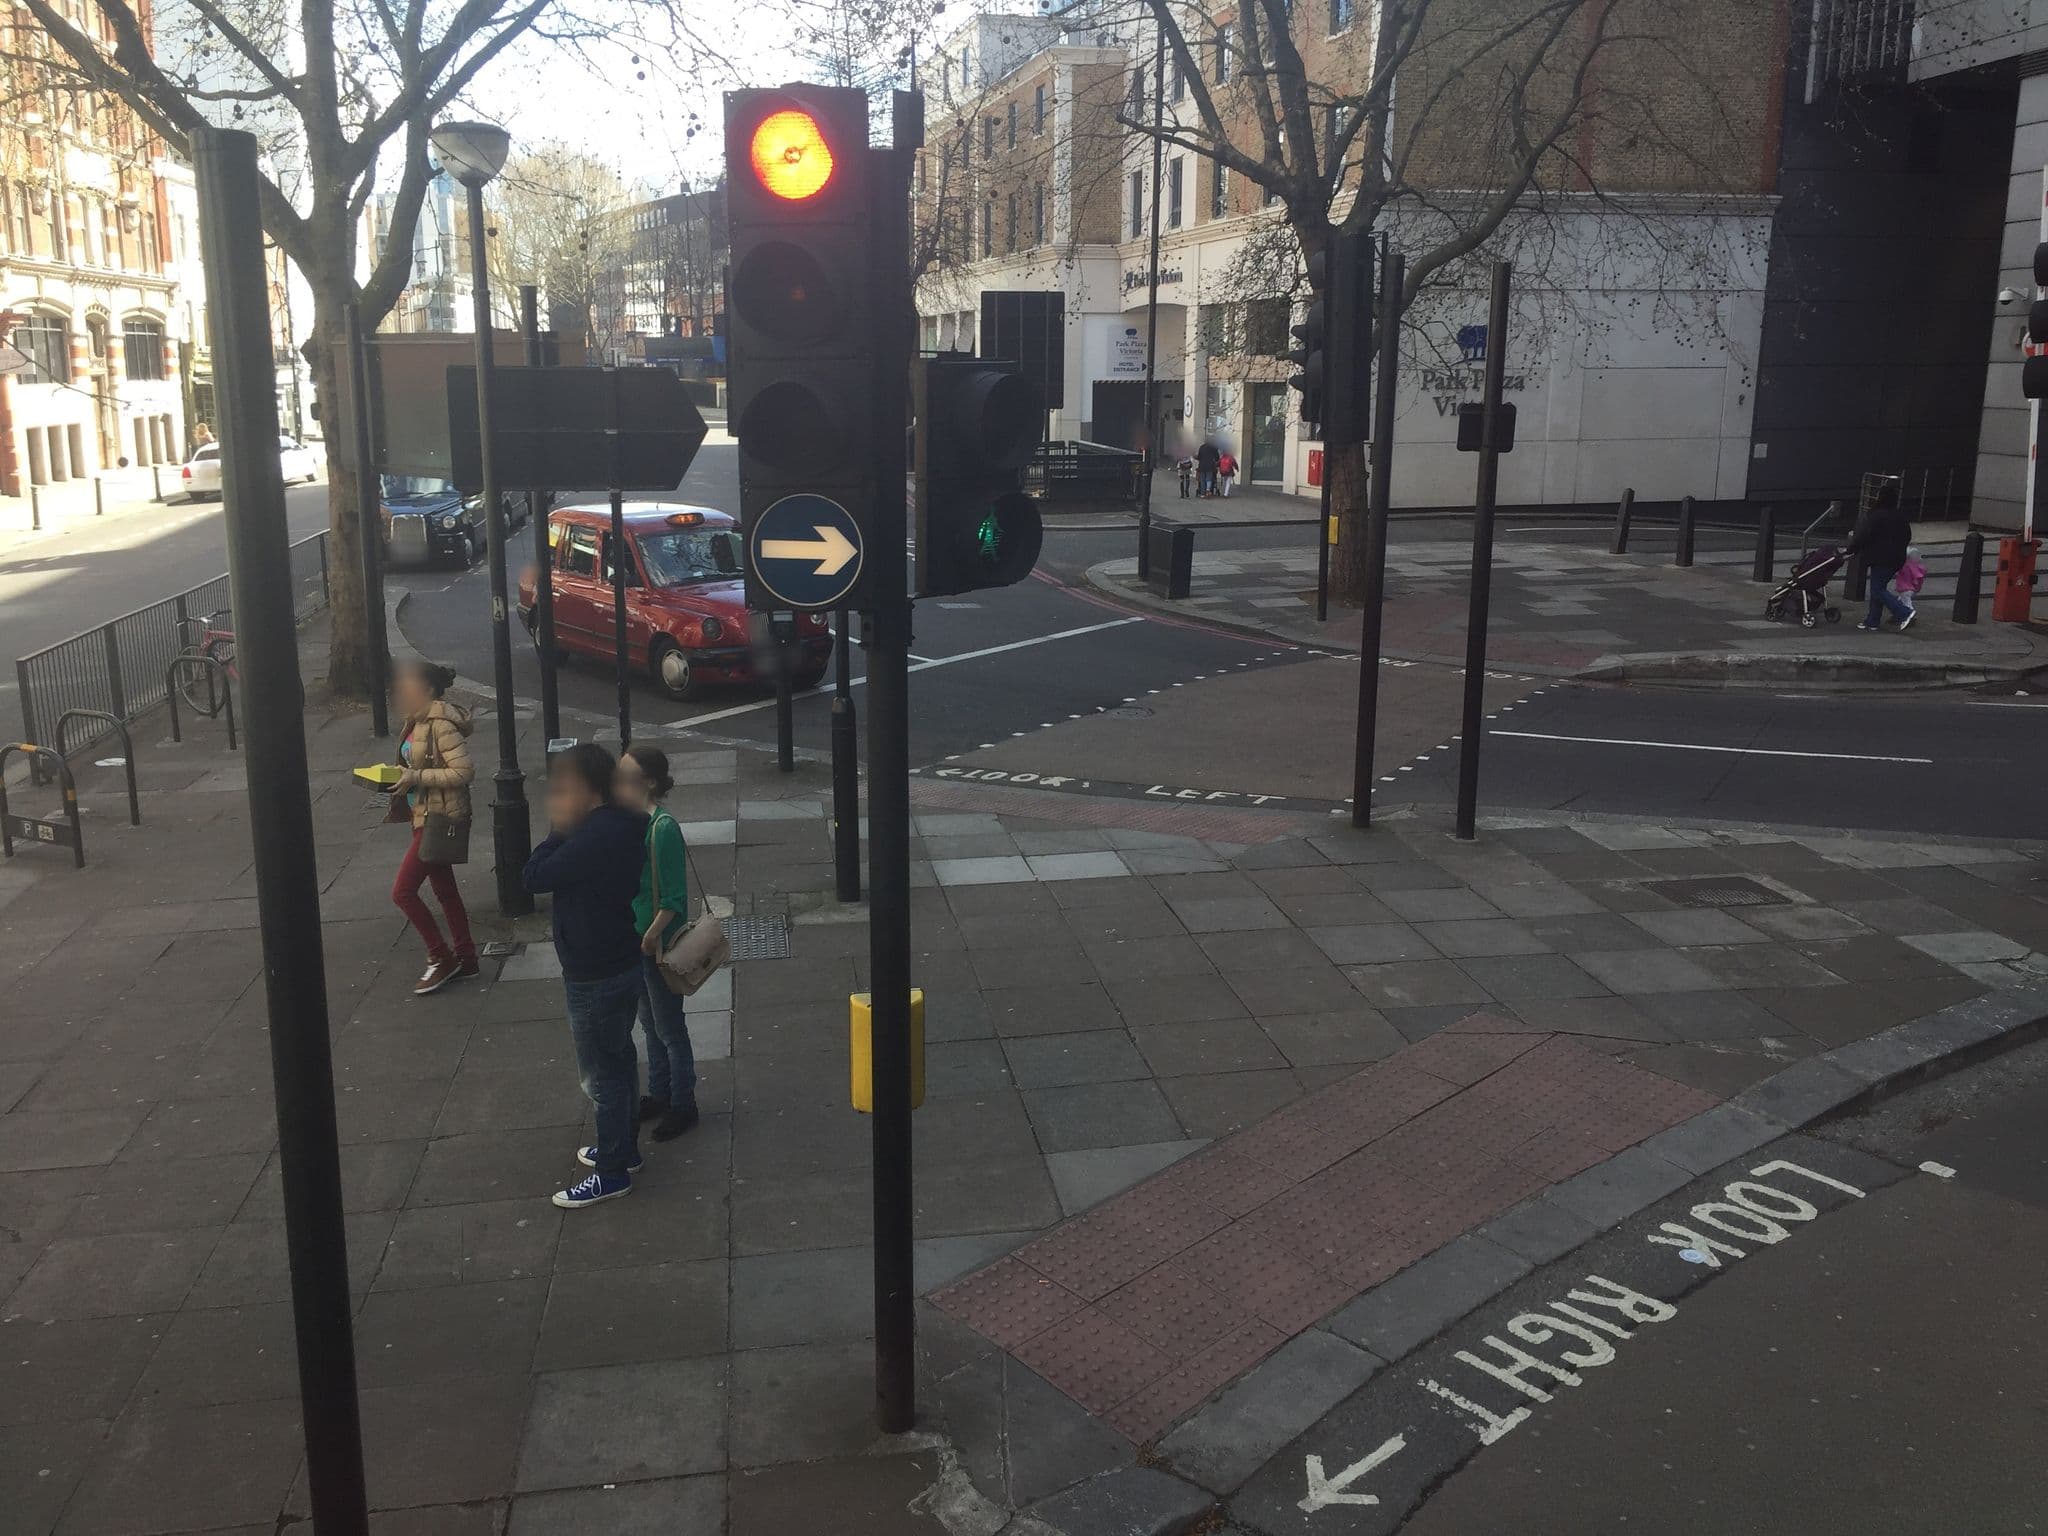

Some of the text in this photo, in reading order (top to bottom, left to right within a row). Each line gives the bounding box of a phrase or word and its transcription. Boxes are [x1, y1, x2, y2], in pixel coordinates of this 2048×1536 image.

[1421, 368, 1525, 390] Park Pza
[961, 769, 1287, 804] LOOK LEFT
[1417, 1159, 1866, 1445] LOOK RIGHT
